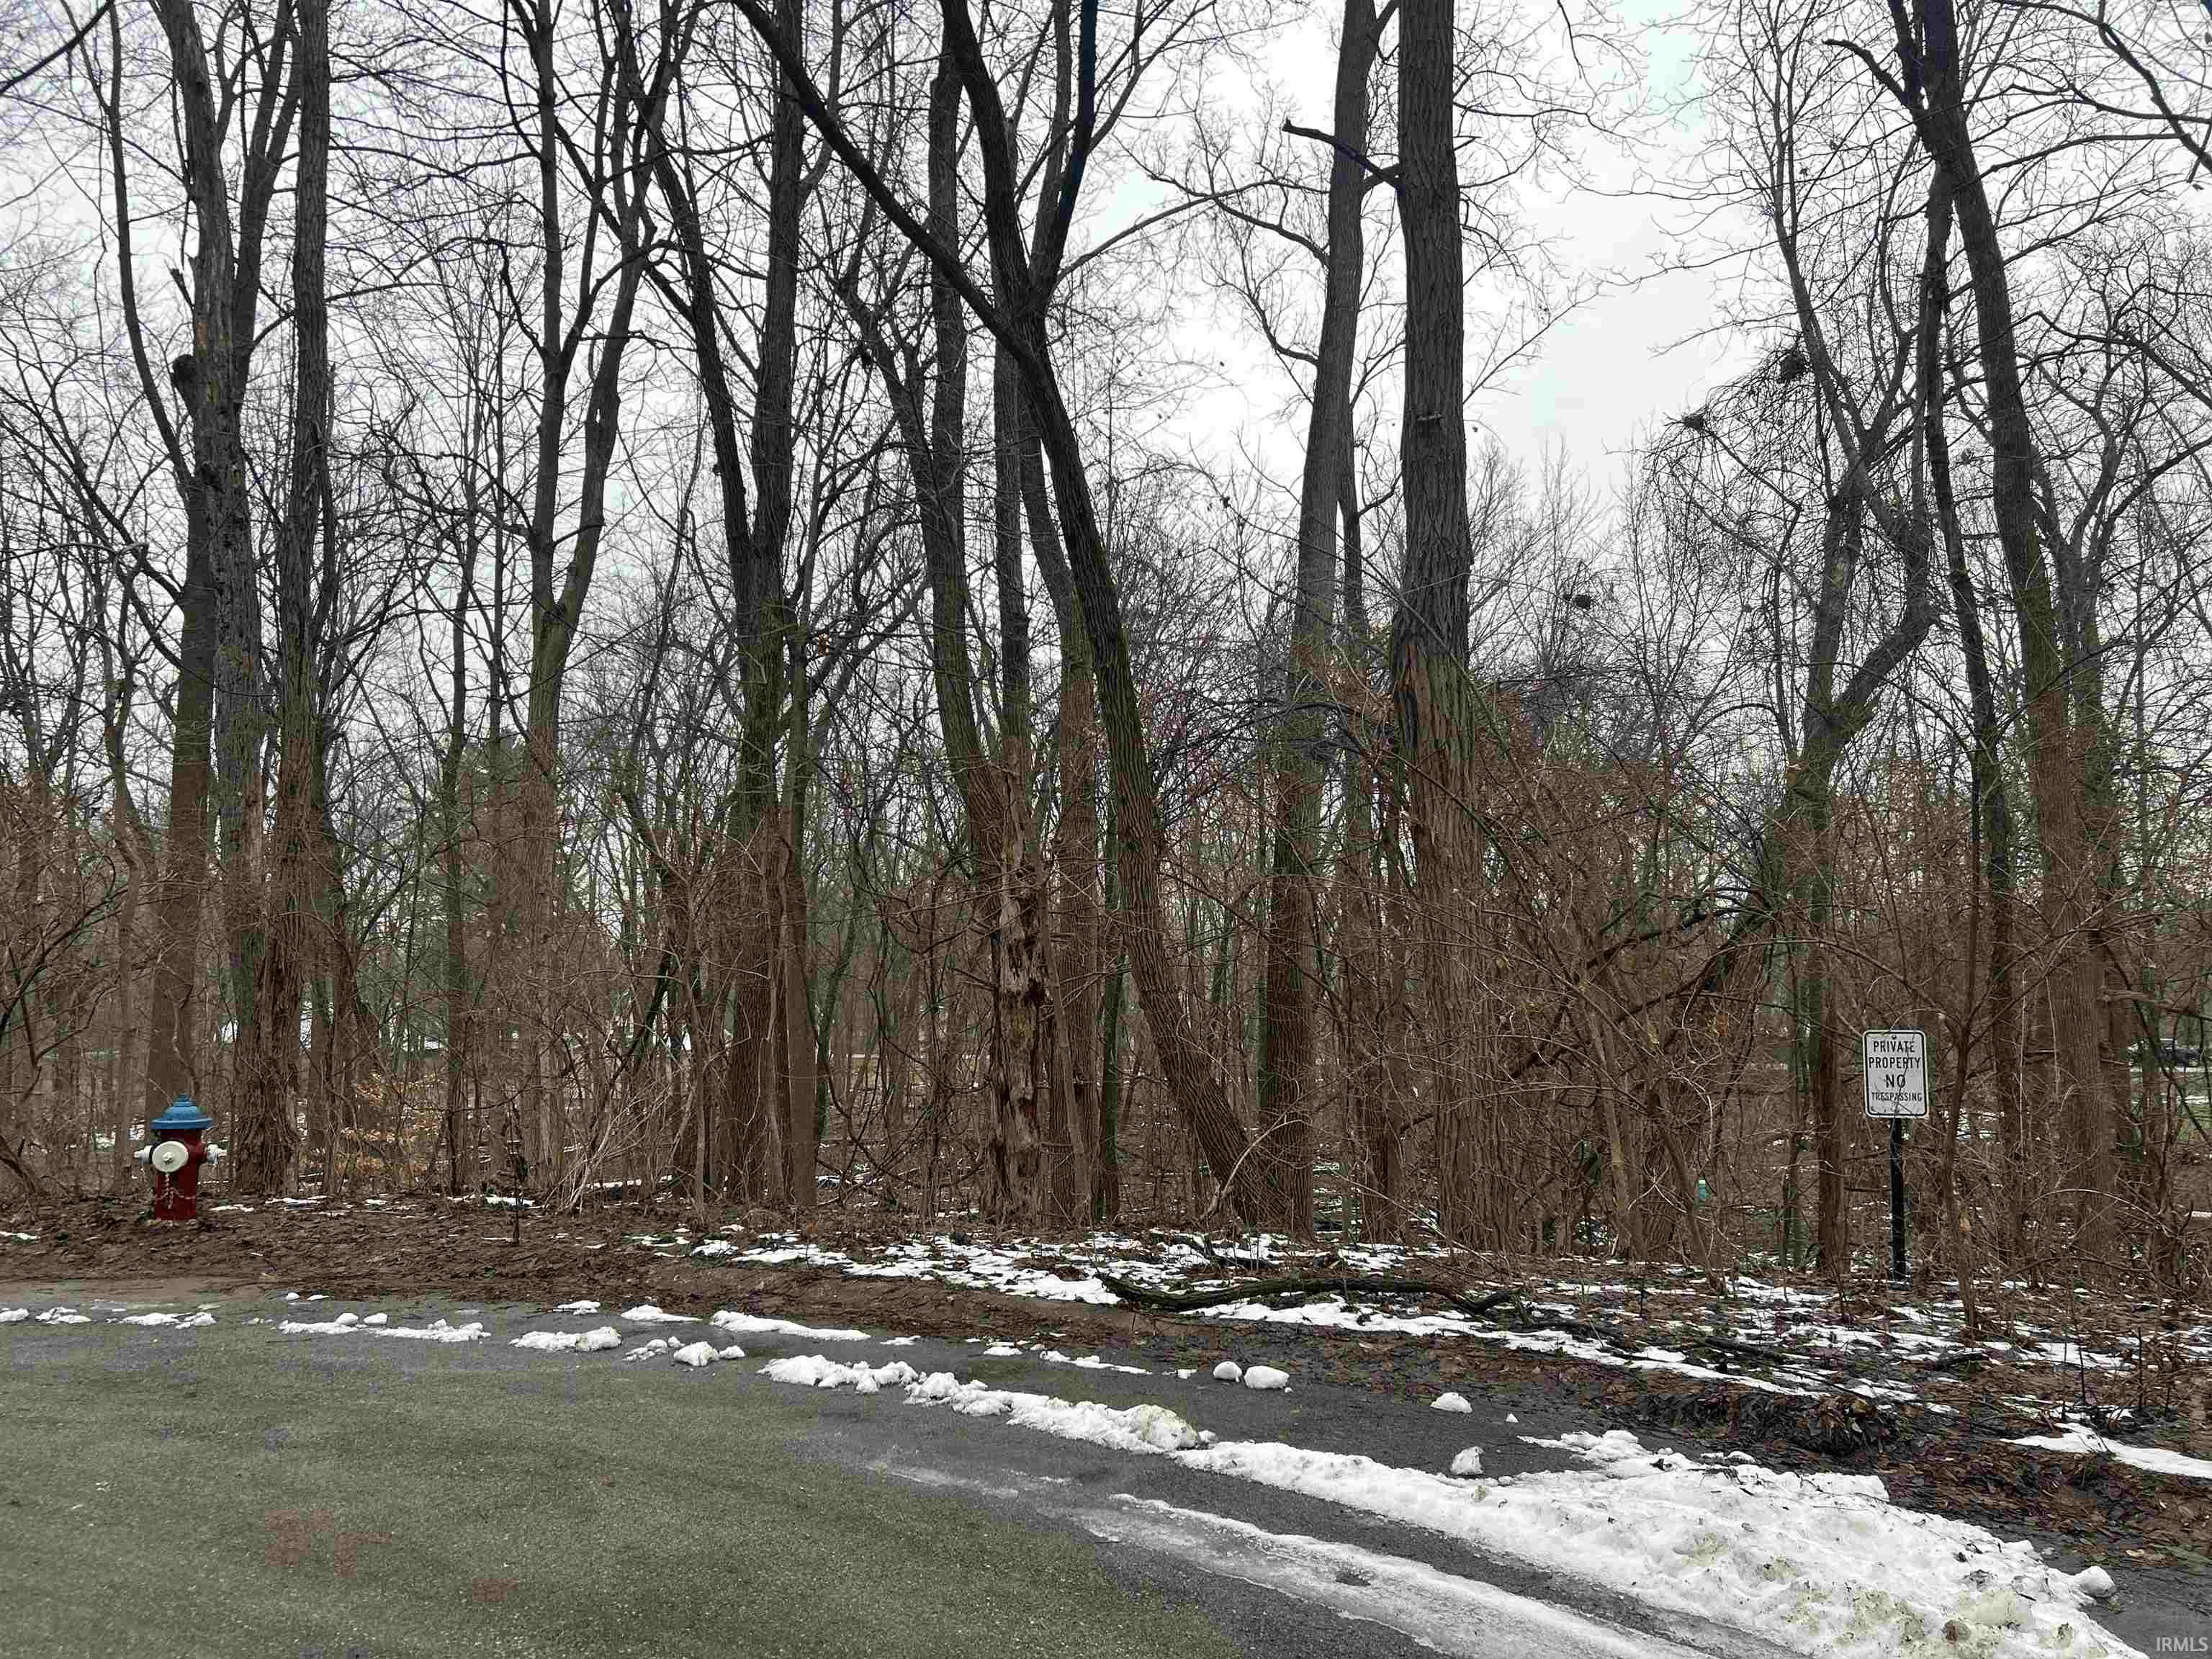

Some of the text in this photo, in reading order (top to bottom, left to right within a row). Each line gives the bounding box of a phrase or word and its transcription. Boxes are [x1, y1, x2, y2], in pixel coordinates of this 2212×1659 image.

[1873, 1040, 1915, 1053] PRIVATE
[1869, 1056, 1921, 1069] PROPERTY
[1885, 1074, 1906, 1088] NO
[1871, 1092, 1923, 1102] TRESPASSING
